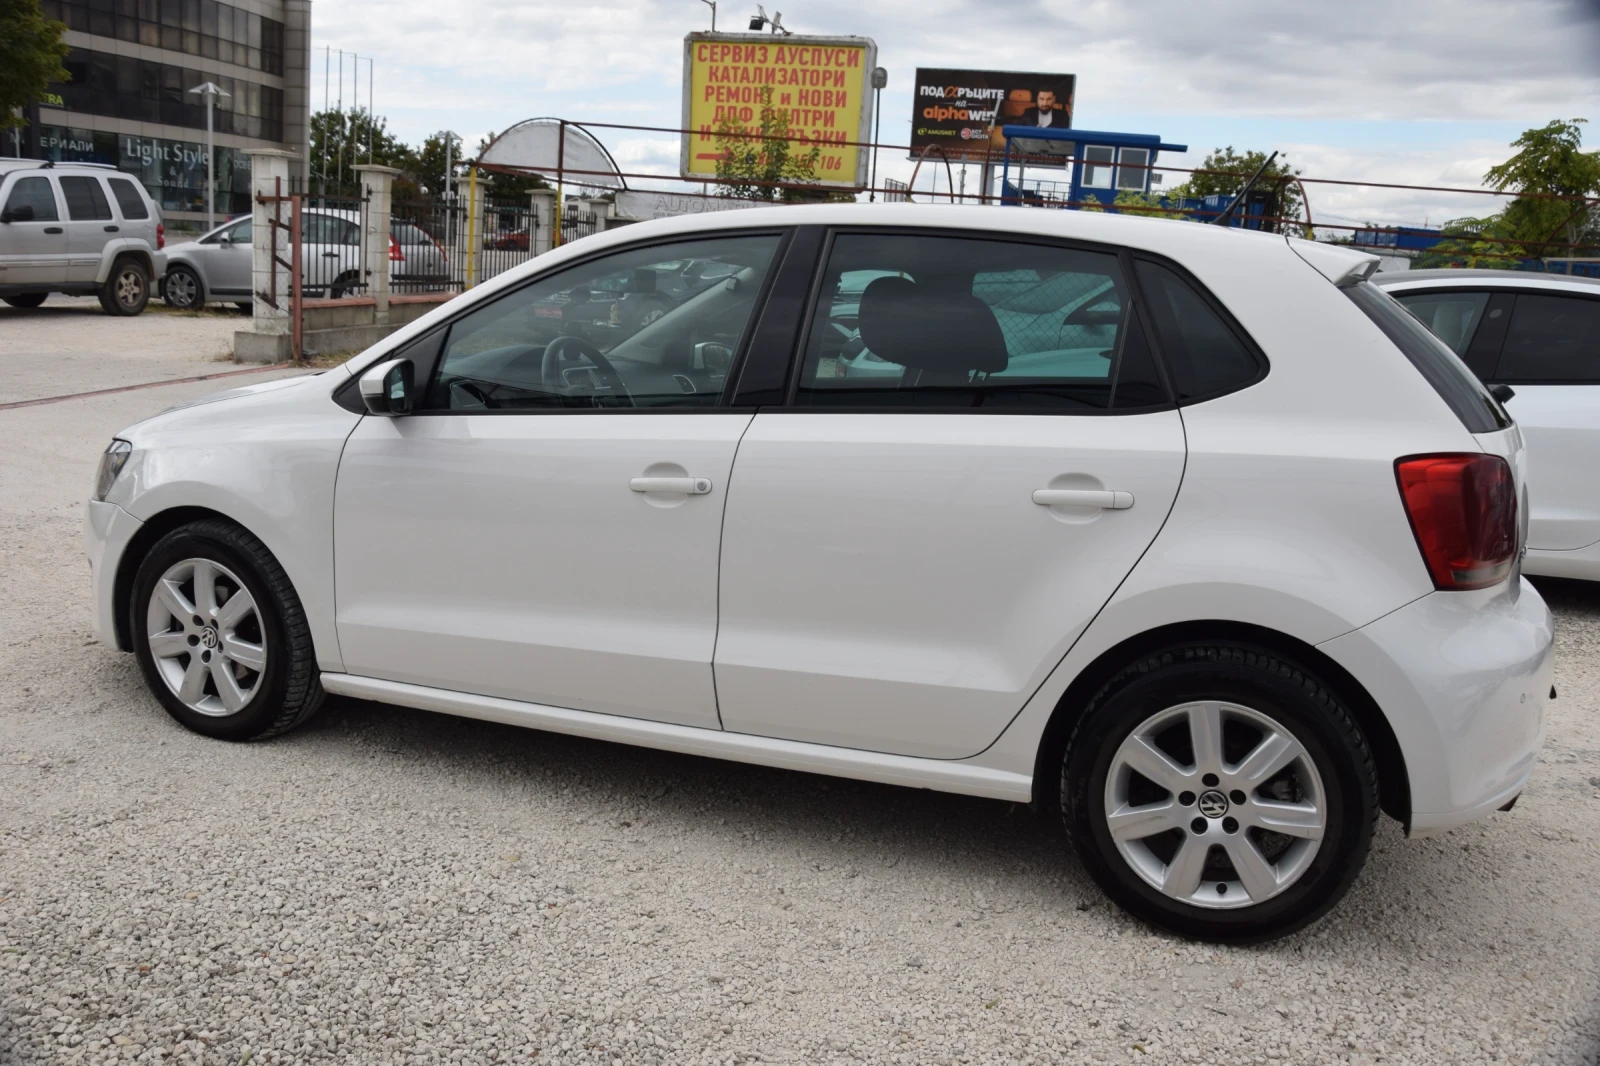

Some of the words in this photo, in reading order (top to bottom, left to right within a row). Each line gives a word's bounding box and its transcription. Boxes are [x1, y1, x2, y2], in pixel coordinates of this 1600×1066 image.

[697, 44, 769, 64] СЕРВИЗ
[774, 46, 860, 68] АУСПУСИ
[708, 65, 846, 88] КАТАЛИЗАТОРИ
[704, 85, 775, 105] РЕМОНТ
[798, 88, 847, 109] НОВИ
[712, 105, 754, 126] ДПФ
[923, 105, 997, 122] alphawin
[927, 129, 957, 137] AMUSNET
[127, 138, 170, 166] Light
[173, 144, 210, 170] Style
[820, 155, 842, 170] 106
[157, 176, 190, 189] Sound
